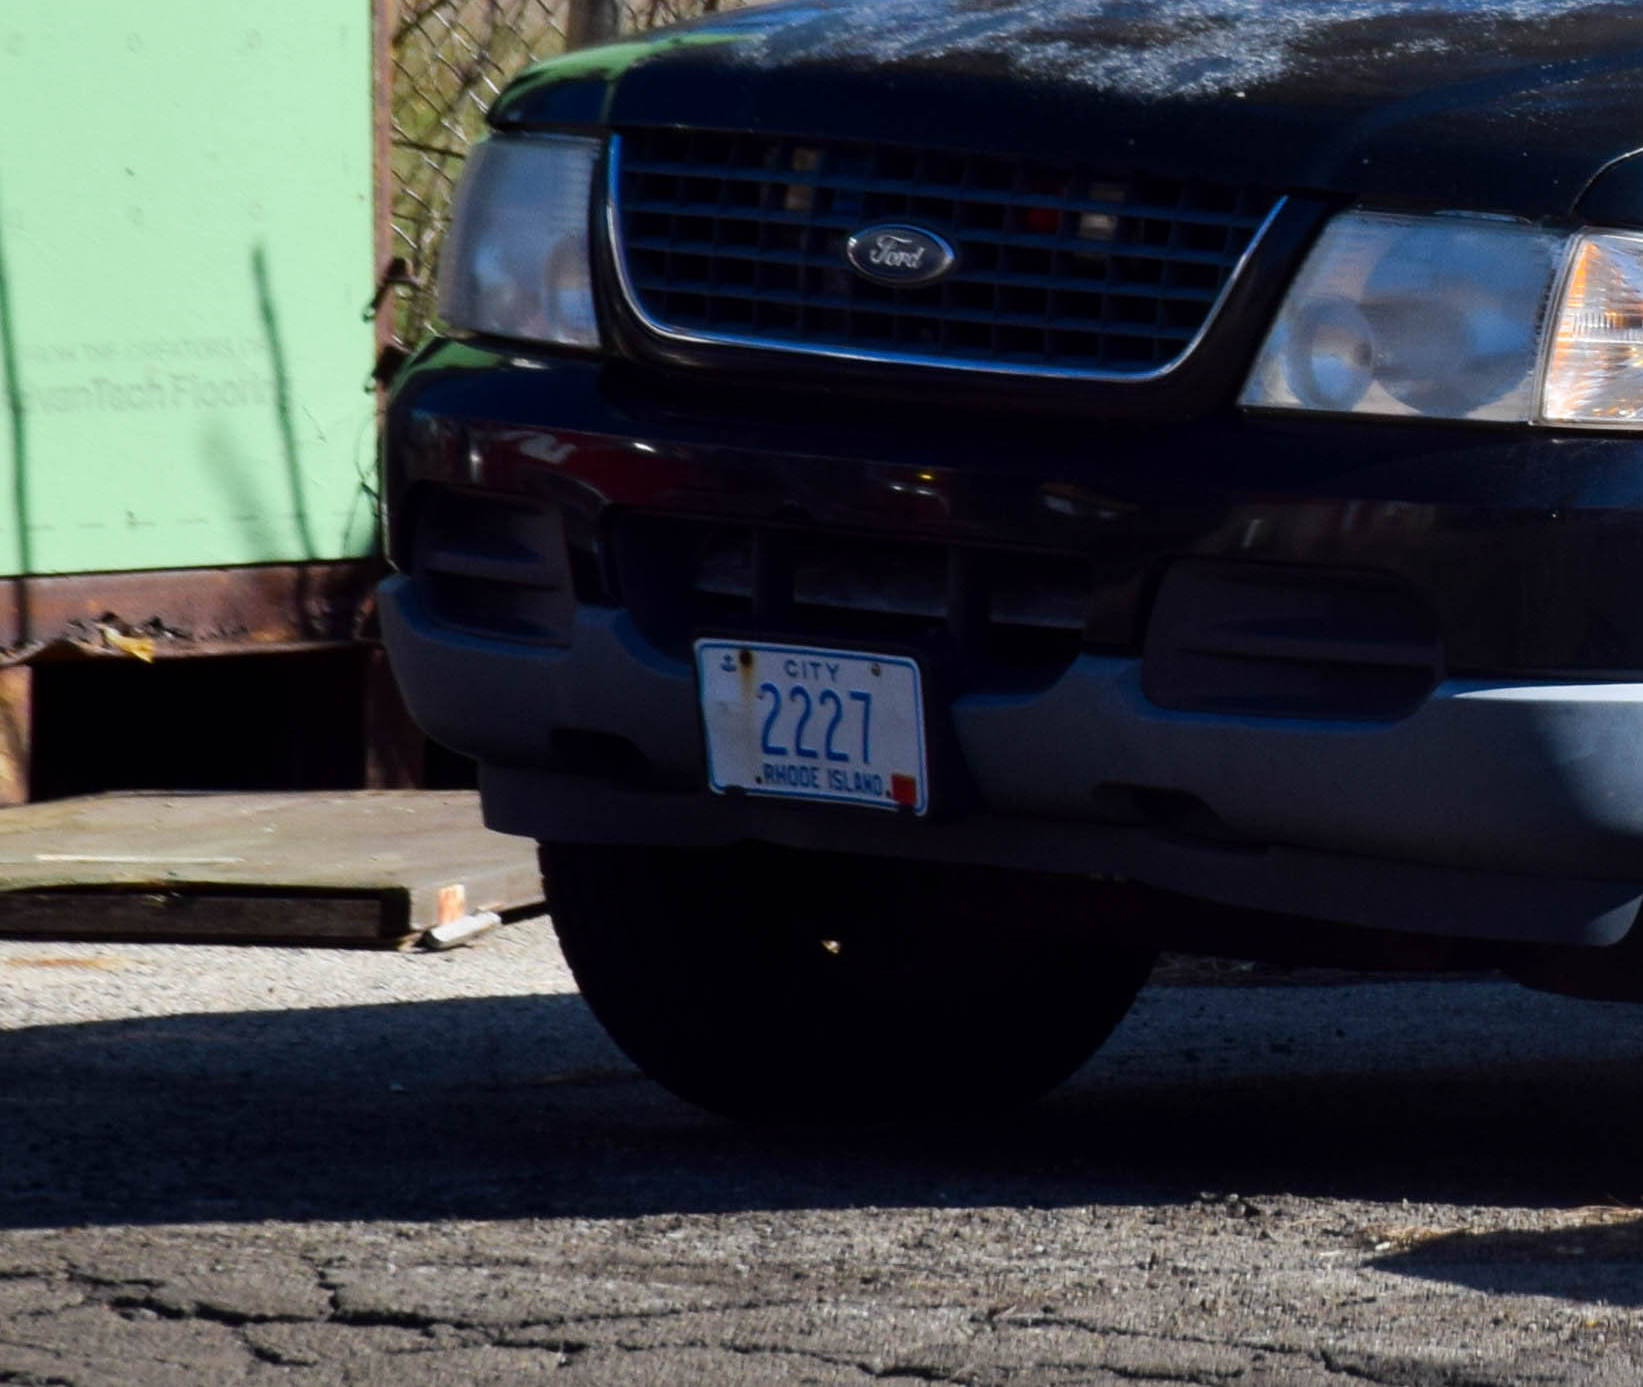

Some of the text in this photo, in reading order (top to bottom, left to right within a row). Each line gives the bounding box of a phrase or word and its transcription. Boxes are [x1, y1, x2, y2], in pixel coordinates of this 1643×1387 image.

[870, 235, 925, 268] Ford
[785, 659, 840, 682] CITY
[758, 682, 871, 764] 2227
[764, 762, 883, 797] RHODE ISLAND
